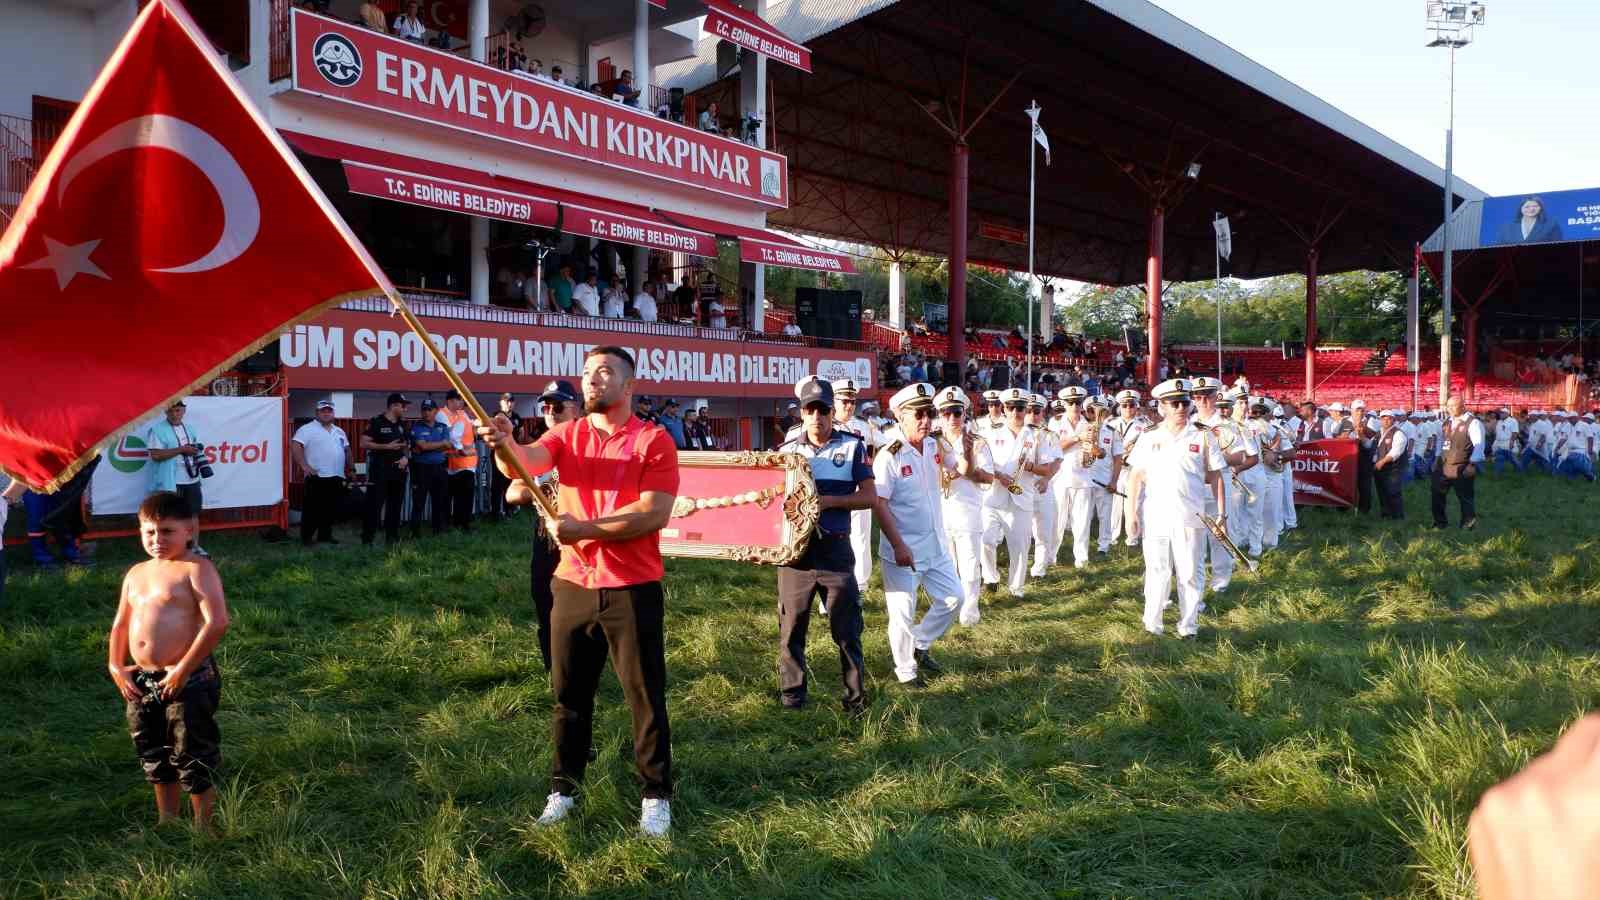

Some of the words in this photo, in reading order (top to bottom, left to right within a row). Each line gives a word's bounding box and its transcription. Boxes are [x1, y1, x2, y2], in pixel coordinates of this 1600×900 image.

[716, 21, 730, 37] T.C.
[731, 27, 760, 49] EDİRNE
[760, 39, 801, 65] BELEDİYESİ
[376, 50, 599, 148] ERMEYDANI
[606, 117, 752, 187] KIRKPINAR
[384, 178, 411, 198] T.C.
[413, 183, 461, 207] EDİRNE
[464, 193, 531, 220] BELEDİYESİ
[590, 219, 608, 235] T.C.
[610, 222, 645, 240] EDİRNE
[647, 230, 698, 251] BELEDİYESİ
[761, 247, 775, 262] T.C.
[279, 324, 344, 369] ÜM
[353, 328, 601, 377] SPORCULARIMI
[621, 345, 737, 384] AŞARILAR
[739, 353, 810, 386] DİLERİM
[203, 440, 268, 465] strol
[1292, 458, 1340, 473] DİNİZ
